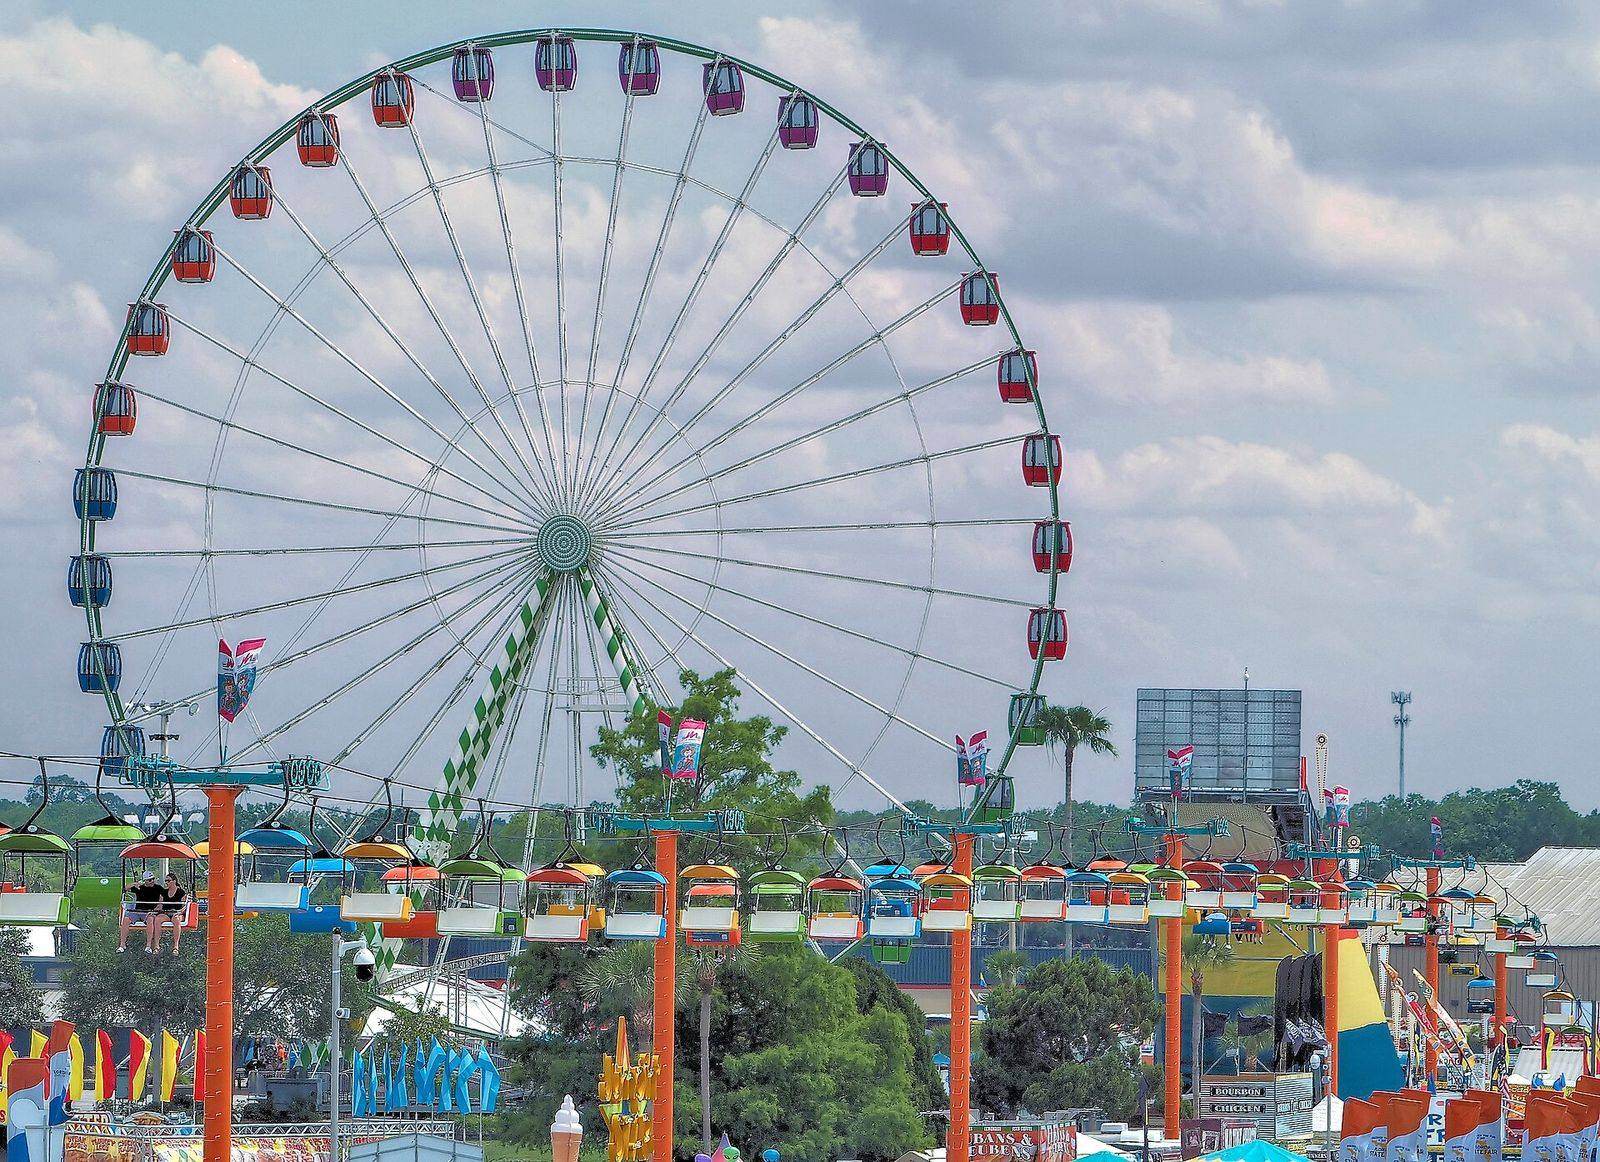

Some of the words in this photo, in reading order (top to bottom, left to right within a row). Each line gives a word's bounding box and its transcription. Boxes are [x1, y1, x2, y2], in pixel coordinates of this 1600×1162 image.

[1215, 1088, 1261, 1096] BOURBON
[1214, 1105, 1261, 1113] CHICKEN
[968, 1133, 1015, 1145] BANS
[968, 1144, 1030, 1160] EUBENS
